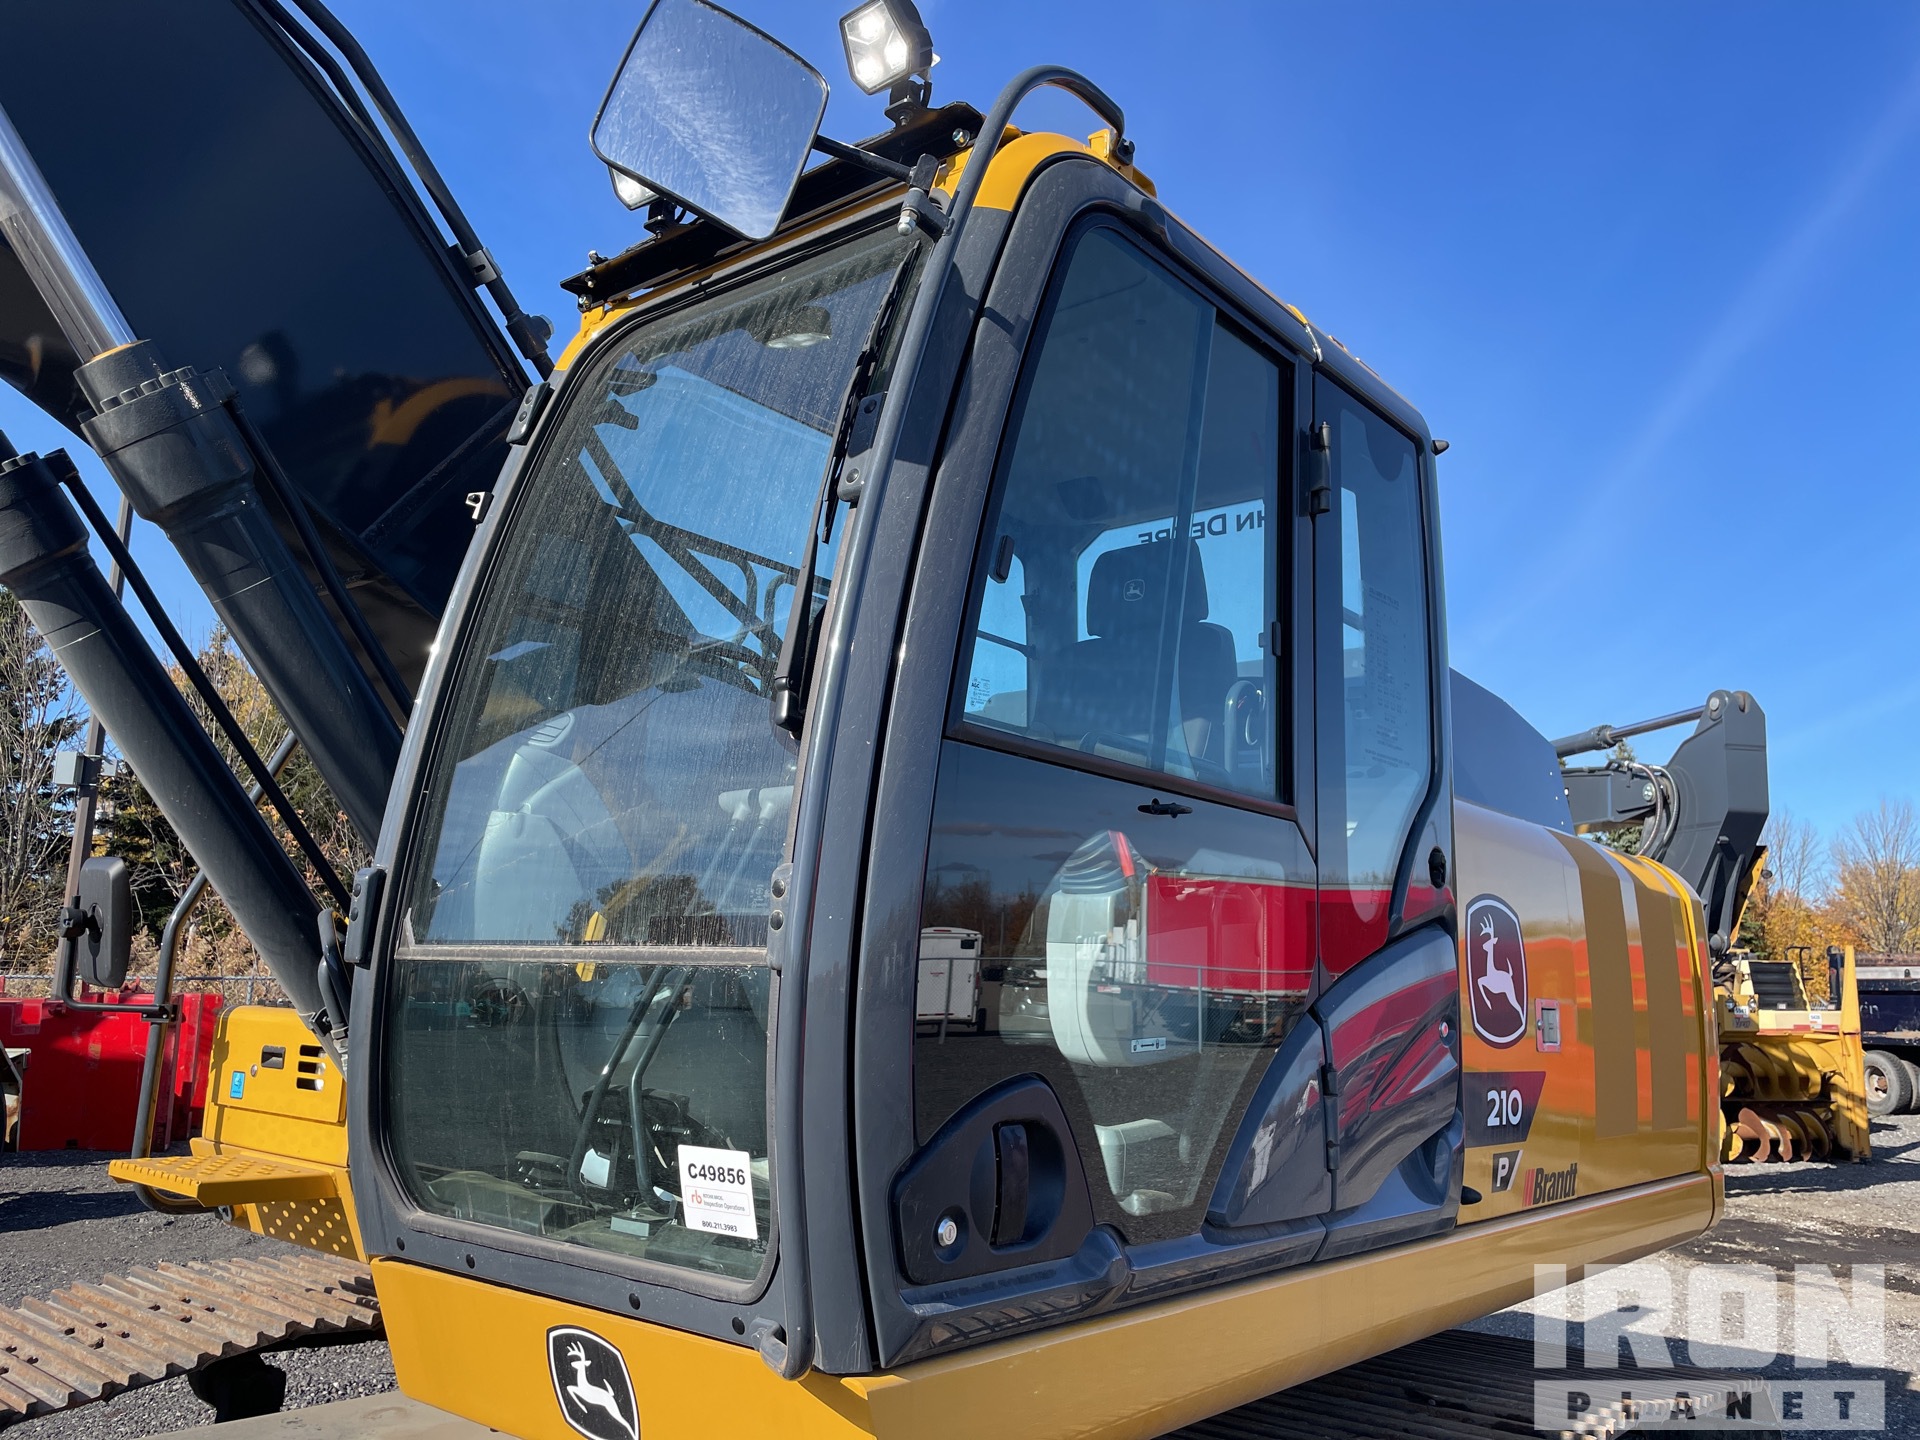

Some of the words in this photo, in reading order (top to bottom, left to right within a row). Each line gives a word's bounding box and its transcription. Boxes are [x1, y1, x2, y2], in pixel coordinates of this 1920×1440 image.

[1487, 1089, 1523, 1127] 210
[688, 1163, 746, 1185] C49856
[1496, 1157, 1510, 1187] P
[1532, 1163, 1578, 1205] Brandt
[724, 1202, 746, 1212] Operations
[701, 1220, 738, 1232] 800.211.3983
